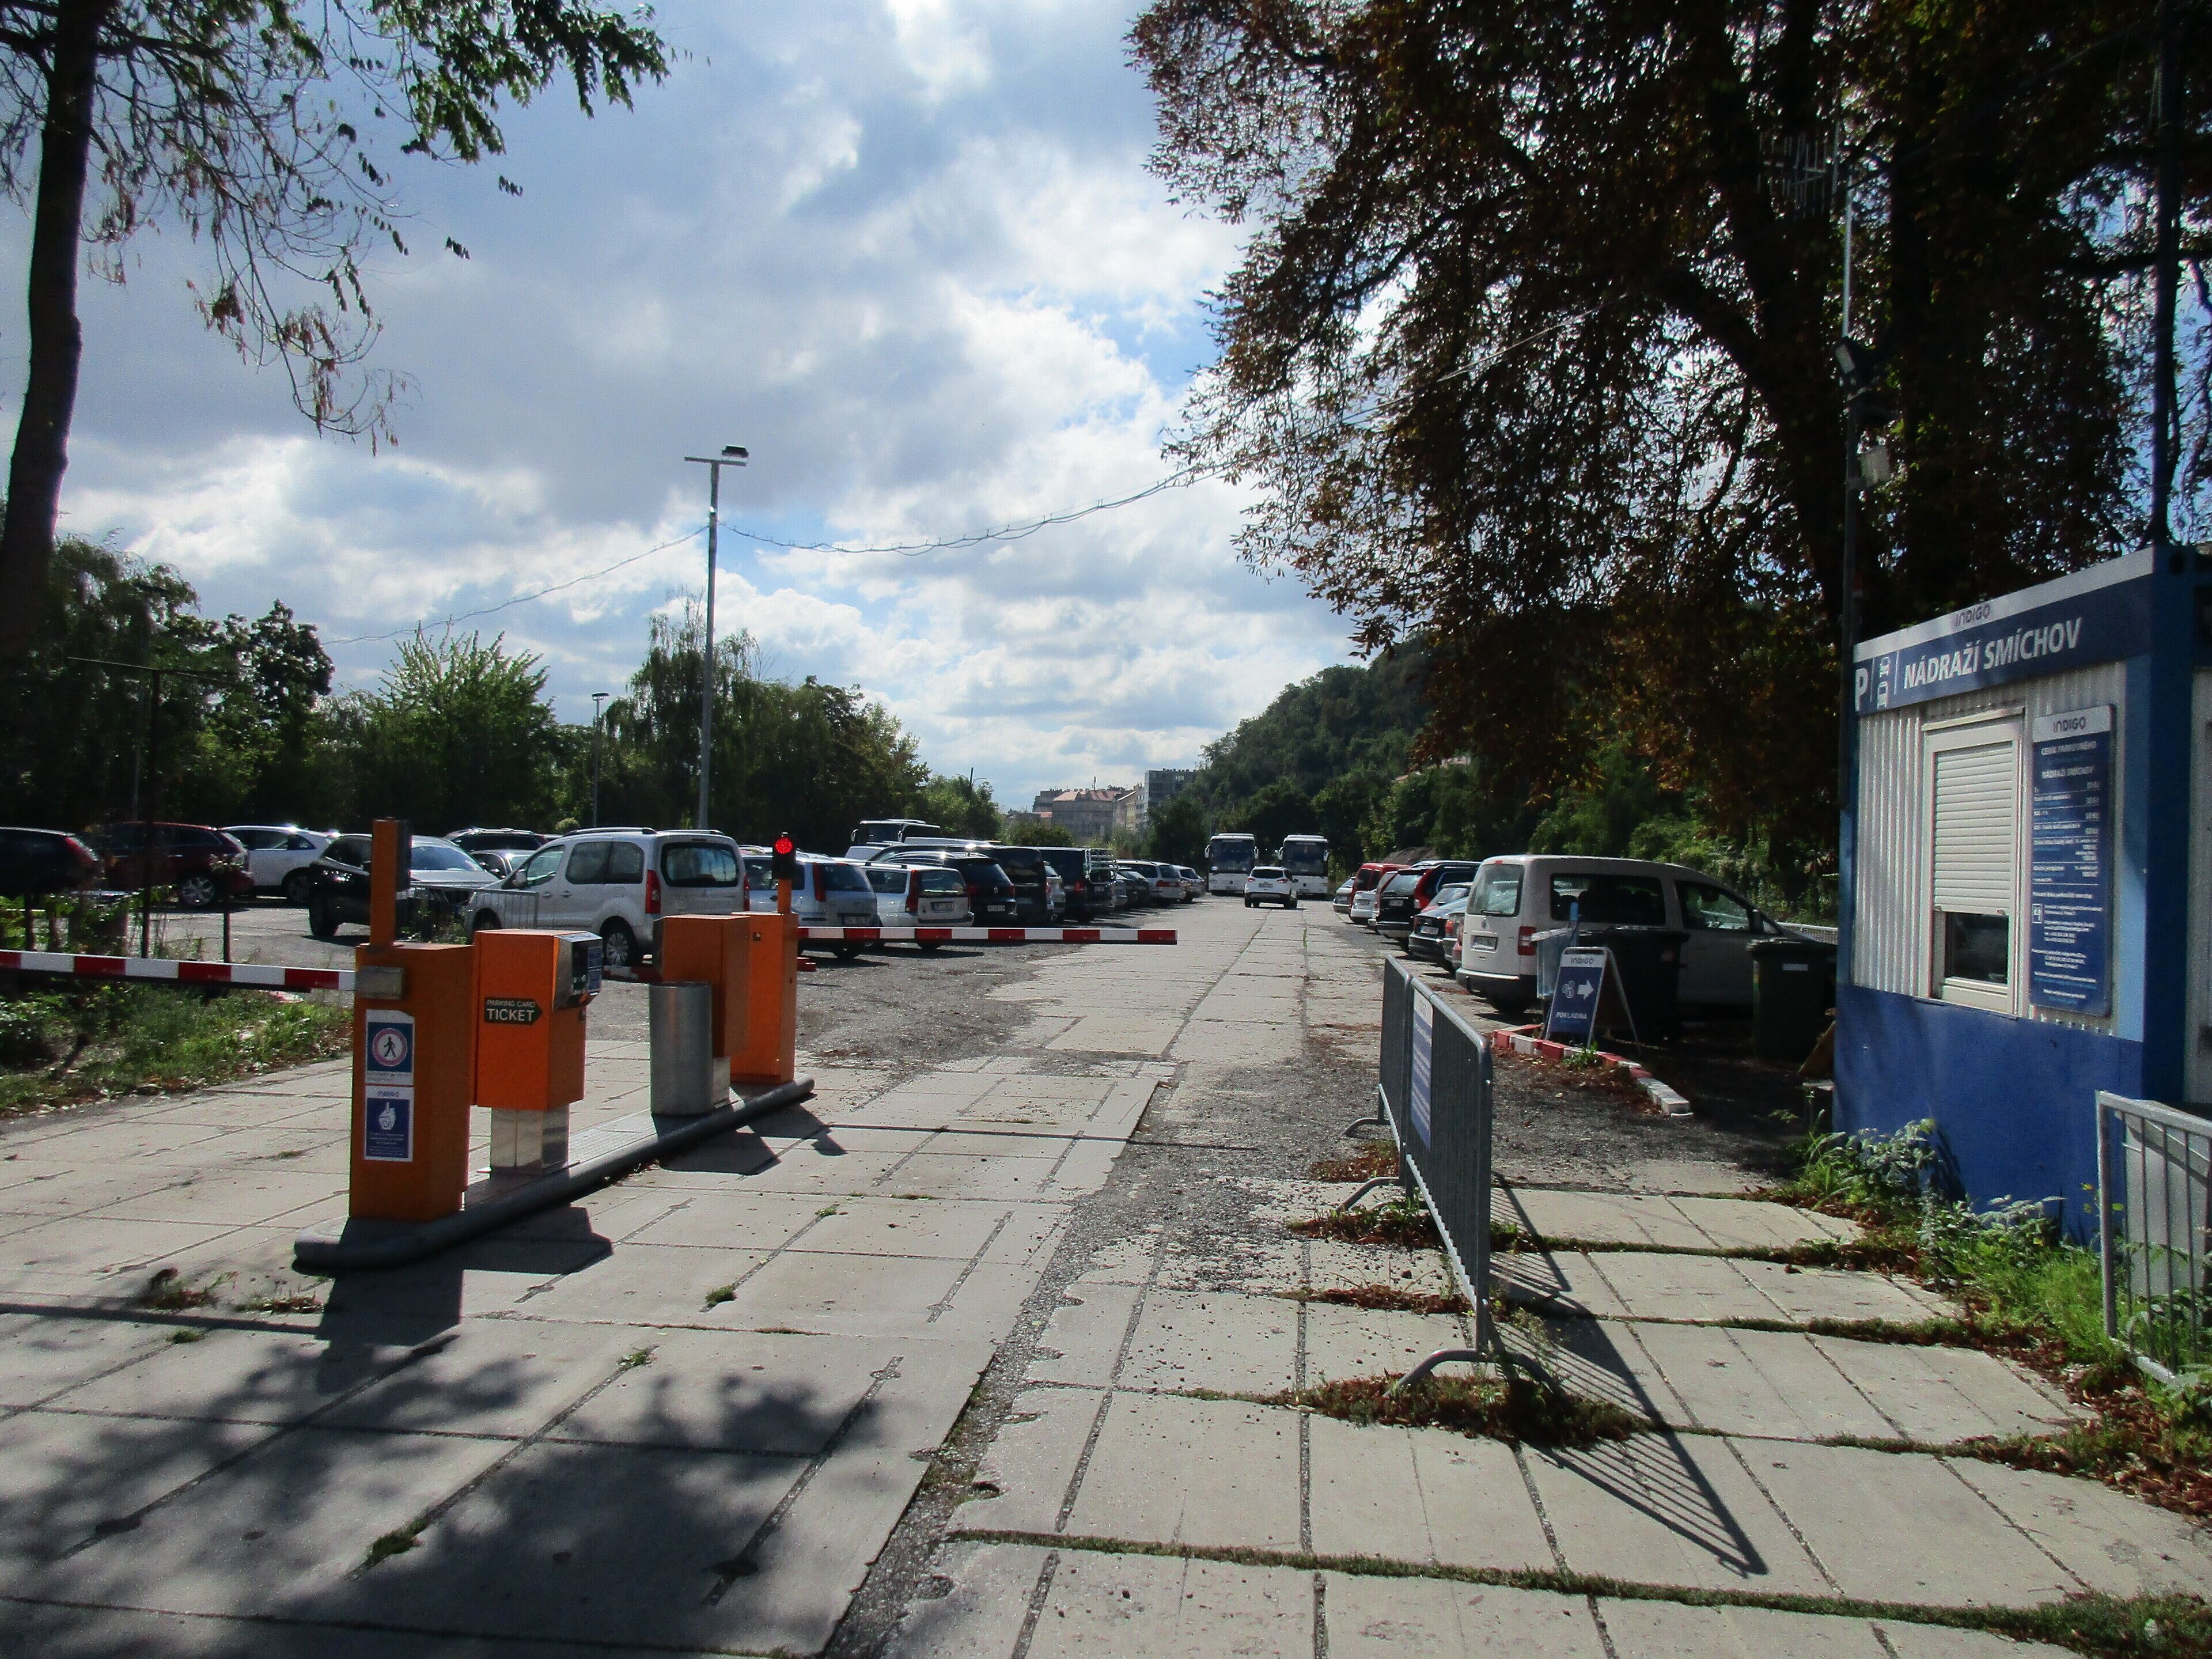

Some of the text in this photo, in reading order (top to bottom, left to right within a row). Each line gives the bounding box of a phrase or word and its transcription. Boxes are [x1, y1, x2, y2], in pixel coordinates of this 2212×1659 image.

[1854, 617, 2083, 712] P NÁDRAŽÍ SMÍCHOV
[487, 1008, 535, 1021] TICKET
